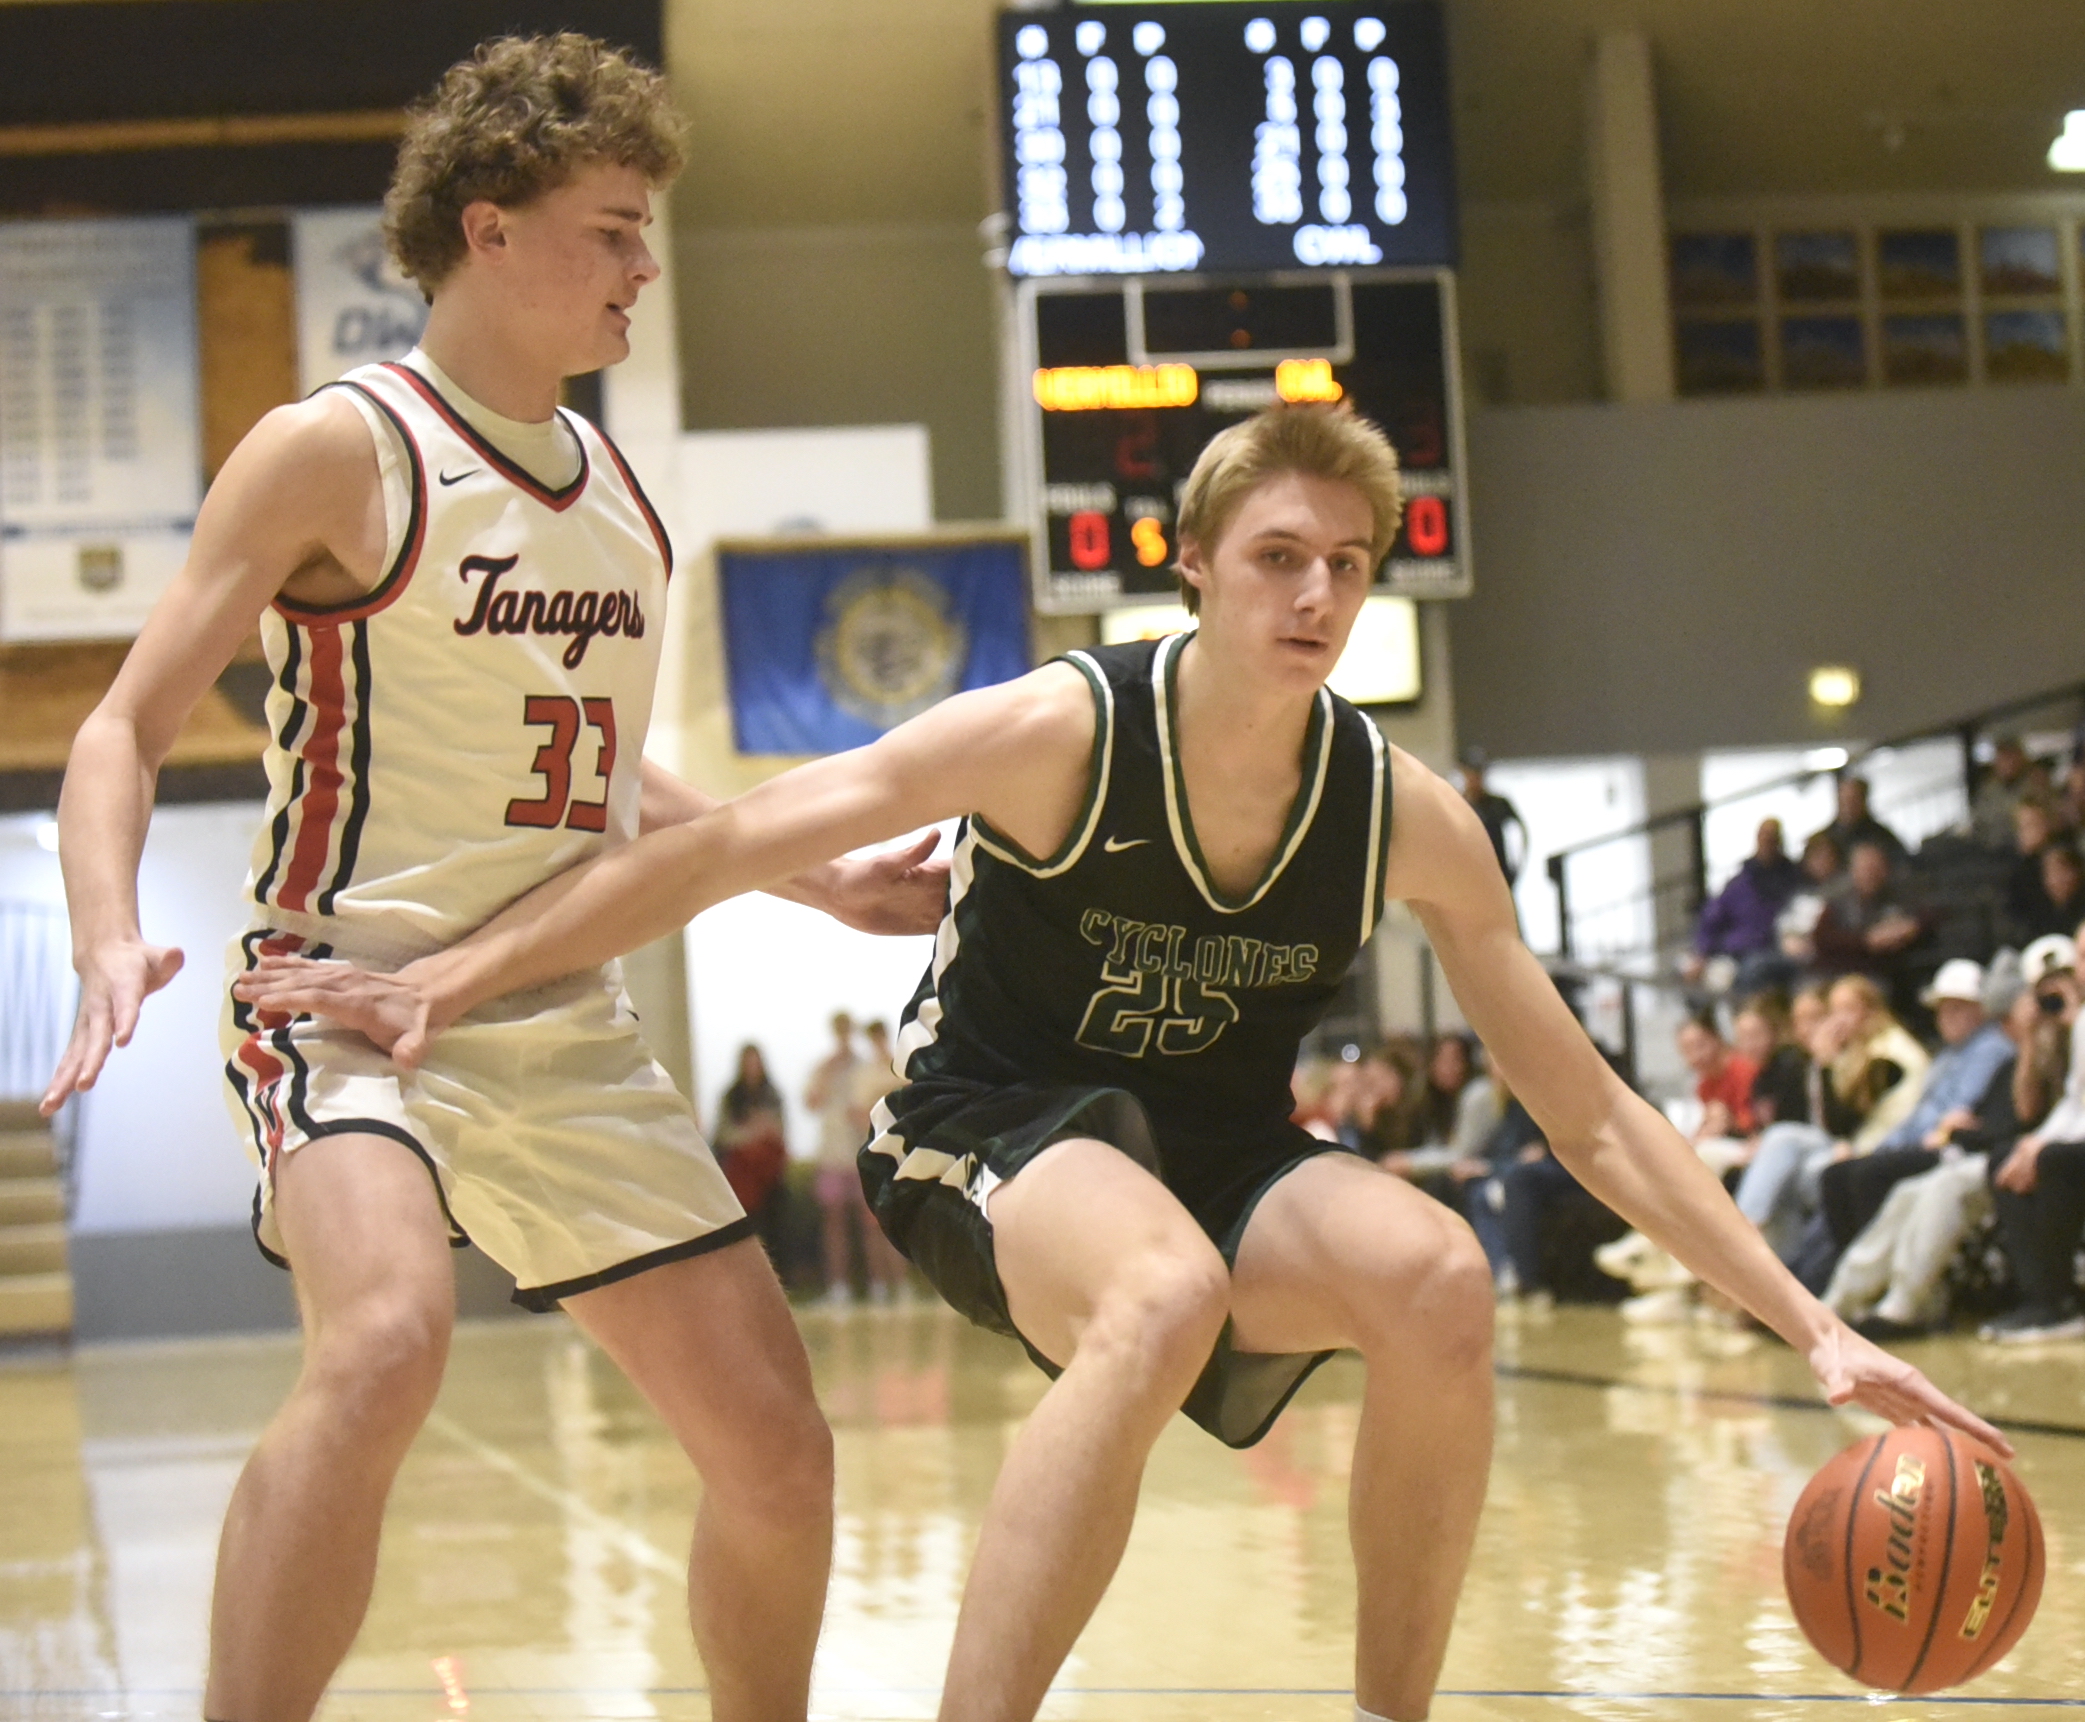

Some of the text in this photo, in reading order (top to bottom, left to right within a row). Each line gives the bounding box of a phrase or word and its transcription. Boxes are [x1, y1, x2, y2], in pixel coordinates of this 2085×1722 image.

[1069, 510, 1111, 571] 0
[1407, 495, 1448, 557] 0
[453, 552, 645, 670] Tanagers
[504, 694, 618, 834] 33
[1079, 907, 1319, 987] CYCLONES
[1074, 960, 1240, 1058] 25
